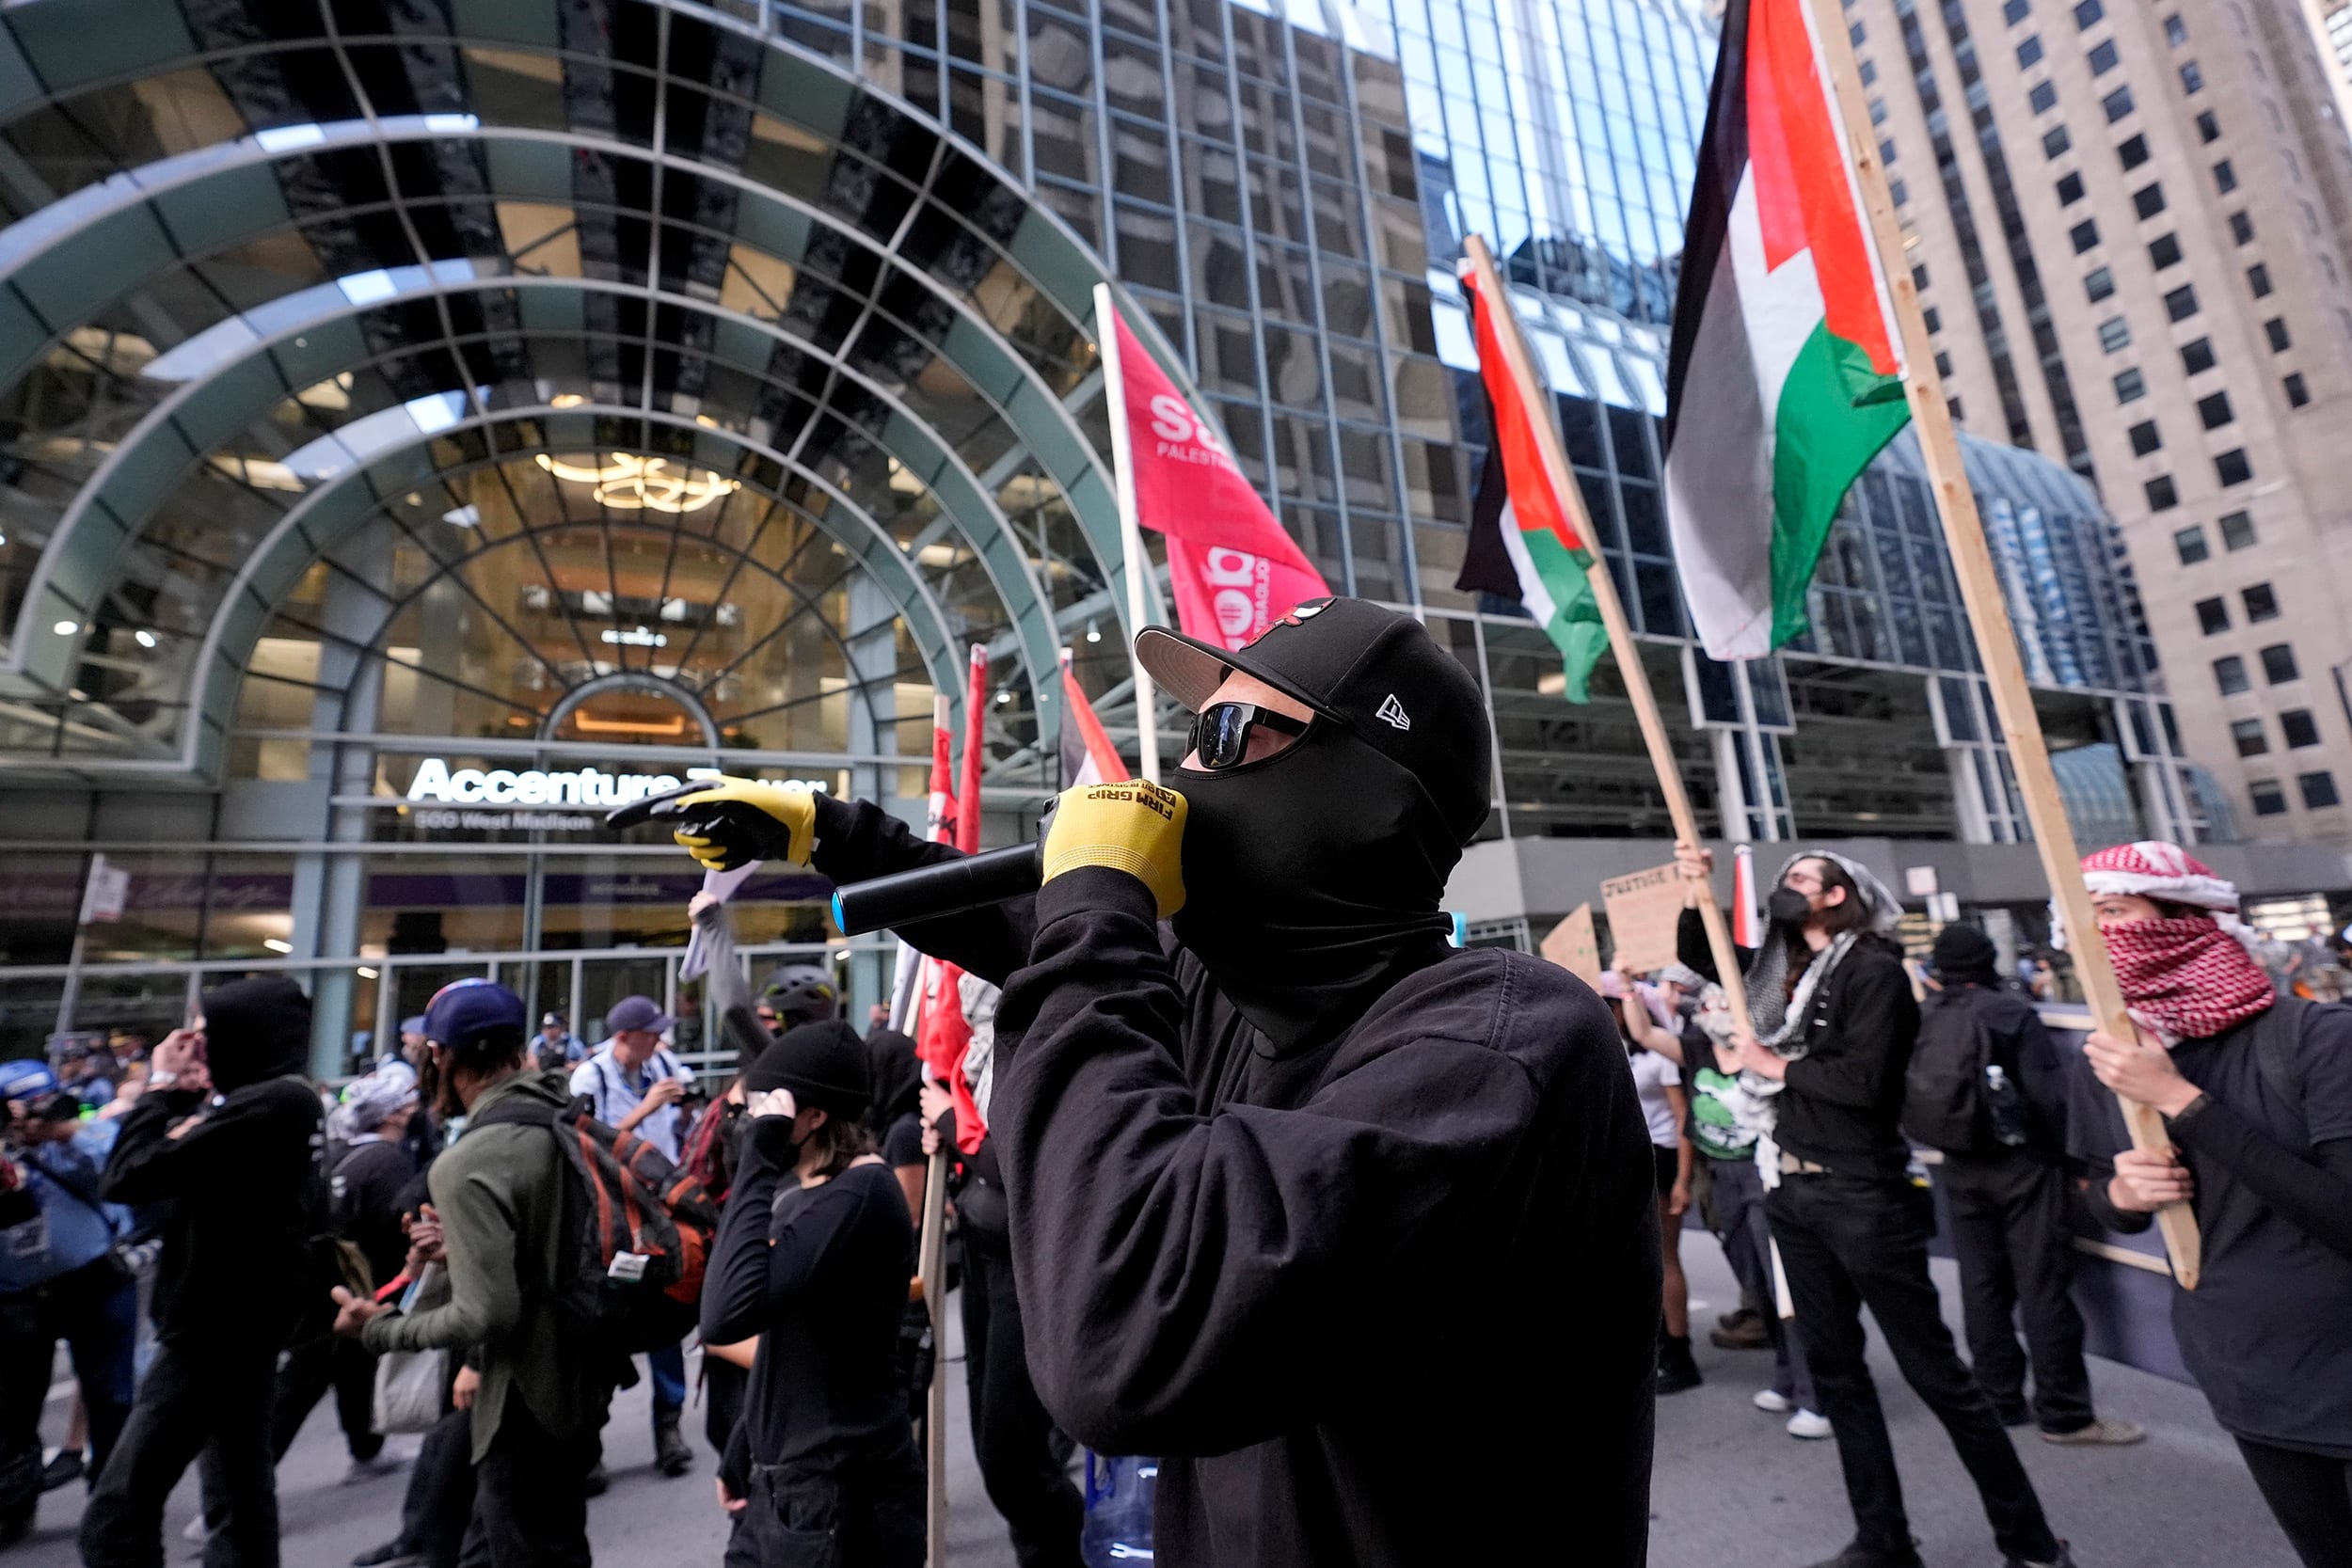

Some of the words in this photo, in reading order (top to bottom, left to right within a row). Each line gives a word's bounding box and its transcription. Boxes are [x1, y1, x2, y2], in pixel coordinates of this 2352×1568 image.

[407, 758, 682, 806] Accenture
[1088, 789, 1133, 801] GRIP
[1136, 792, 1173, 820] FIRM
[462, 812, 511, 830] West
[513, 812, 595, 831] Madison
